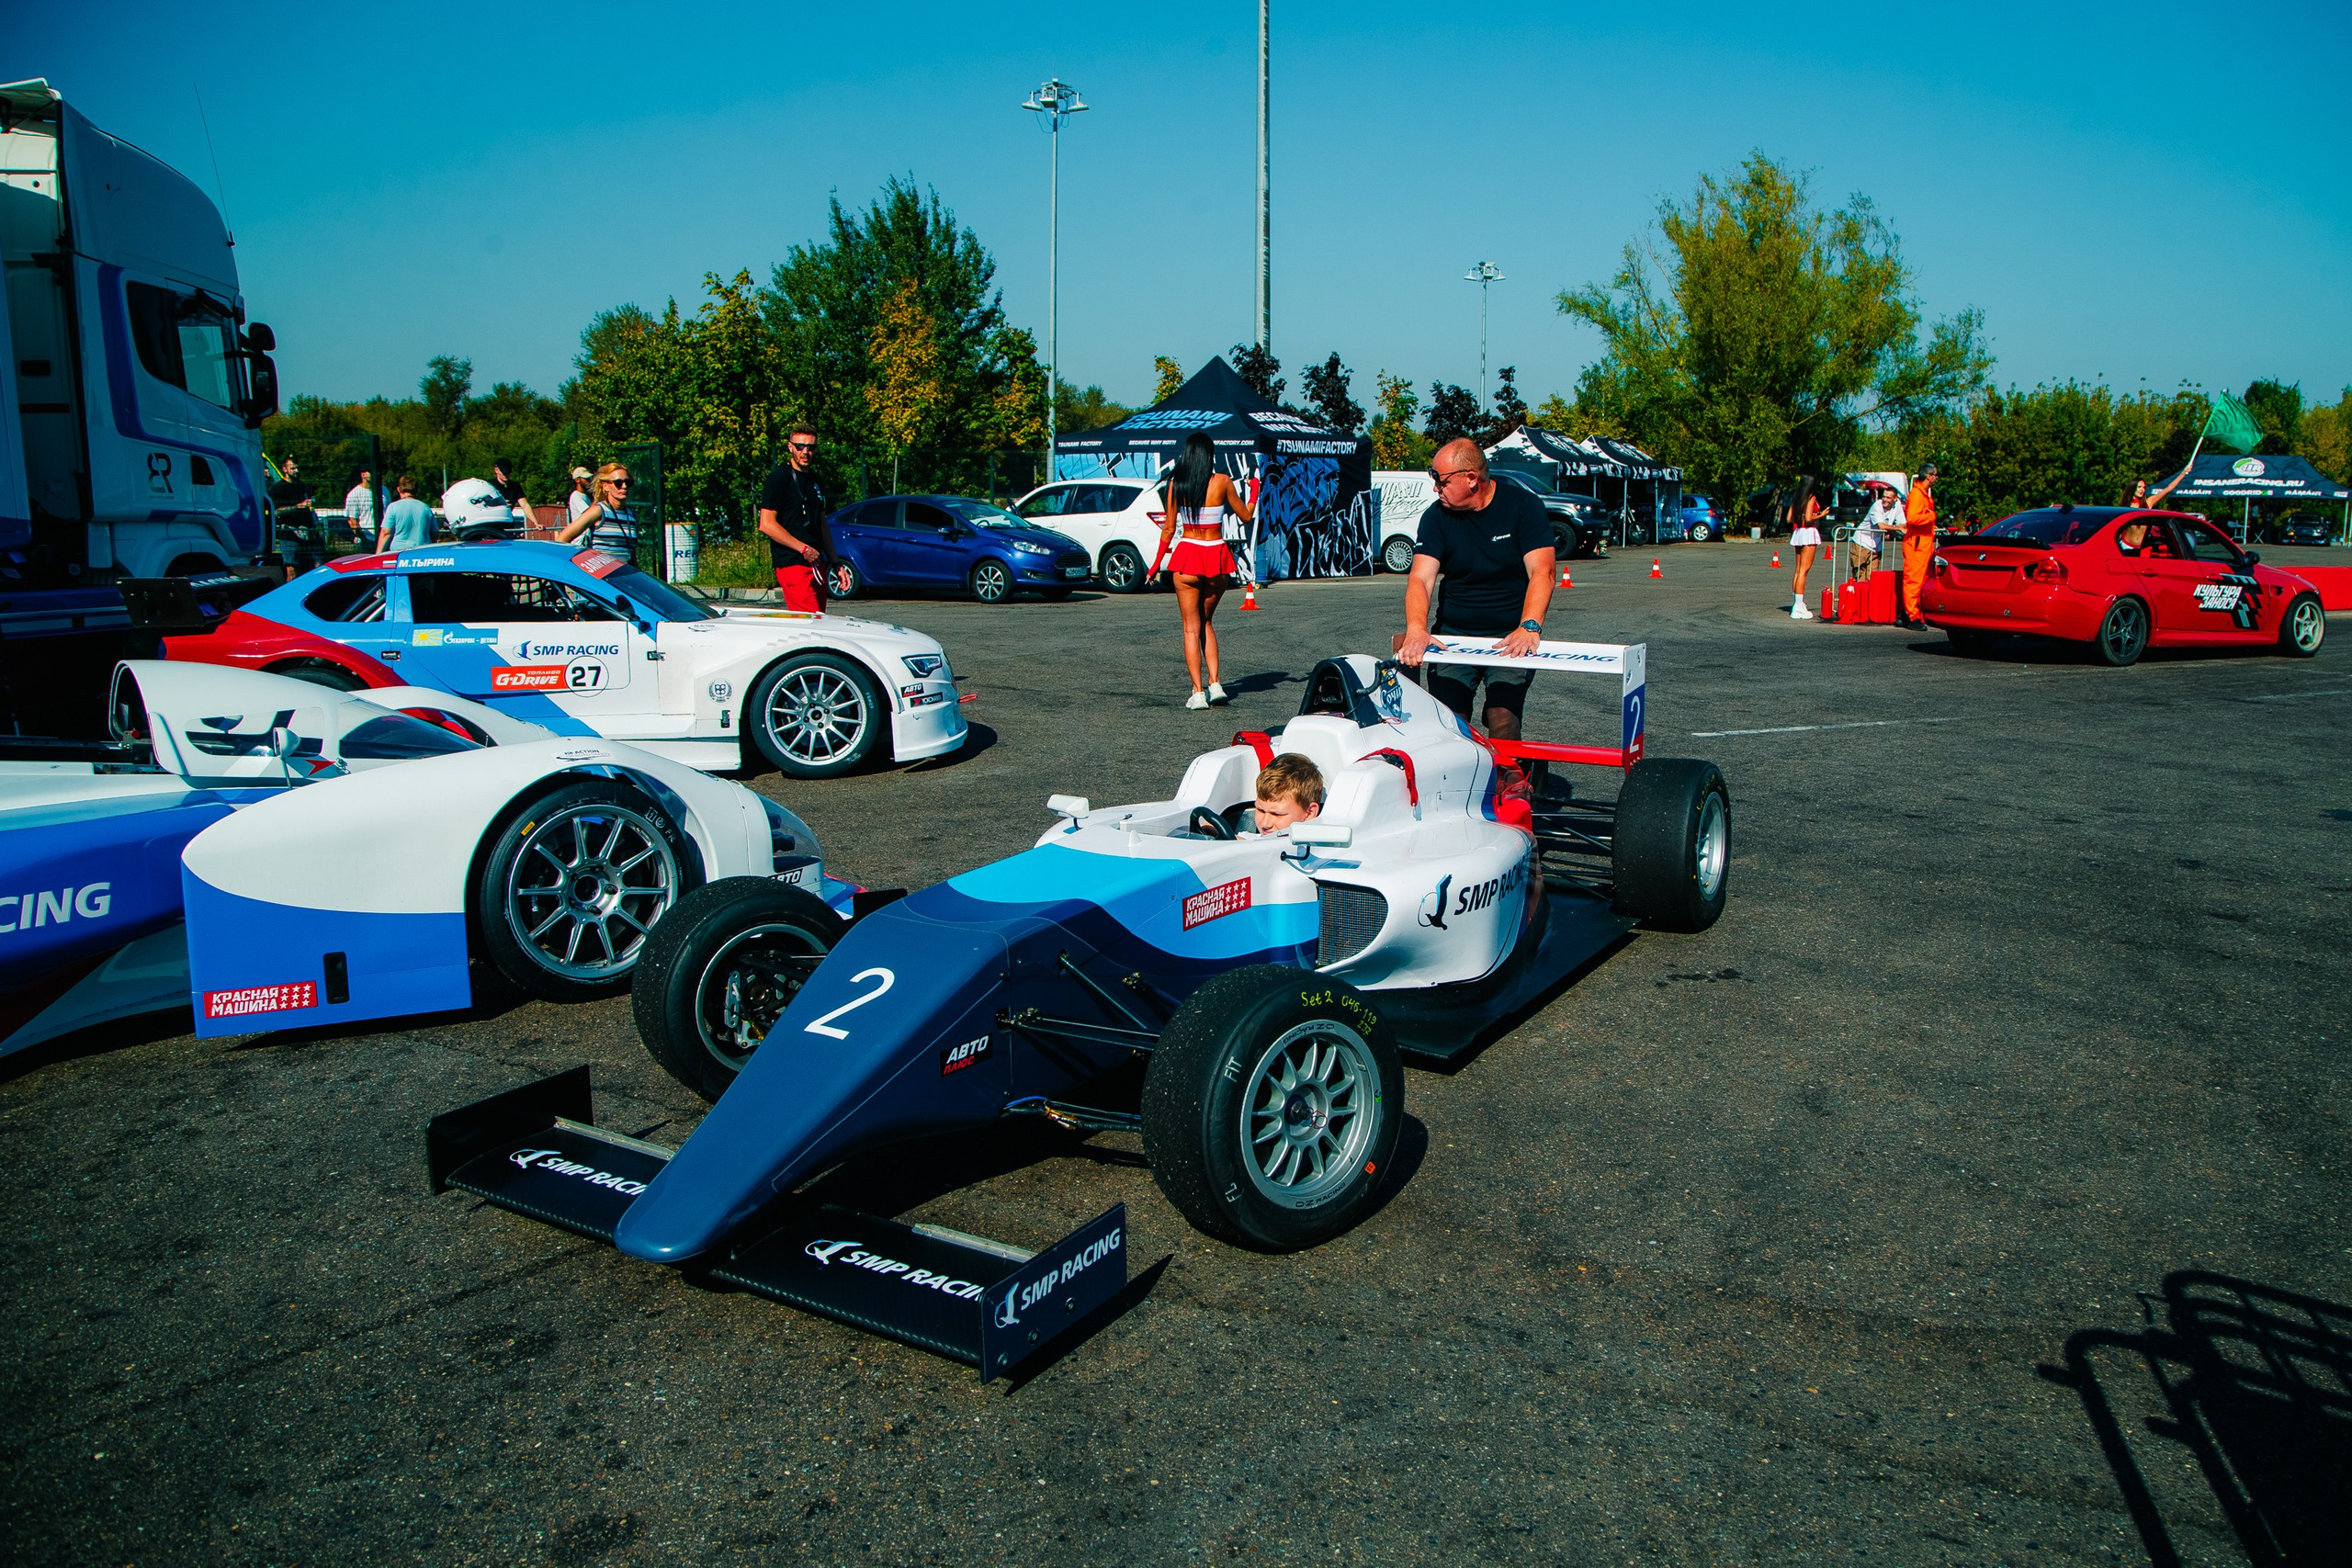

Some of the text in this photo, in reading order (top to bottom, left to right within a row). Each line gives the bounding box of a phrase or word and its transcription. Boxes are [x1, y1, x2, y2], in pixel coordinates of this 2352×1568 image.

[1113, 420, 1224, 430] FACTORY
[1130, 410, 1234, 422] TSUNAMI
[1277, 439, 1357, 454] #TSUNAMIFACTORY
[2193, 478, 2305, 488] INSANERACING.RU
[399, 558, 455, 569] М.ТЫРИНА
[2193, 583, 2243, 598] КУЛЬТУРА
[2199, 596, 2238, 610] ЗАНОСА
[533, 645, 619, 655] SMP RACING
[571, 666, 601, 687] 27
[904, 683, 922, 694] АВТО
[1630, 694, 1640, 754] 2
[1186, 886, 1225, 912] КРАСНАЯ
[1454, 878, 1498, 915] SMP
[1185, 900, 1224, 927] МАШИНА
[212, 987, 279, 1004] КРАСНАЯ
[803, 966, 895, 1040] 2
[1301, 991, 1321, 1007] Set
[1325, 990, 1333, 1003] 2
[211, 999, 277, 1017] МАШИНА
[1283, 1024, 1315, 1043] RACING
[945, 1035, 989, 1064] АВТО
[943, 1055, 975, 1076] ПЛЮС
[537, 1157, 594, 1176] SMP
[1316, 1181, 1346, 1203] RACING
[840, 1250, 911, 1274] SMP
[1021, 1228, 1121, 1311] SMP RACING
